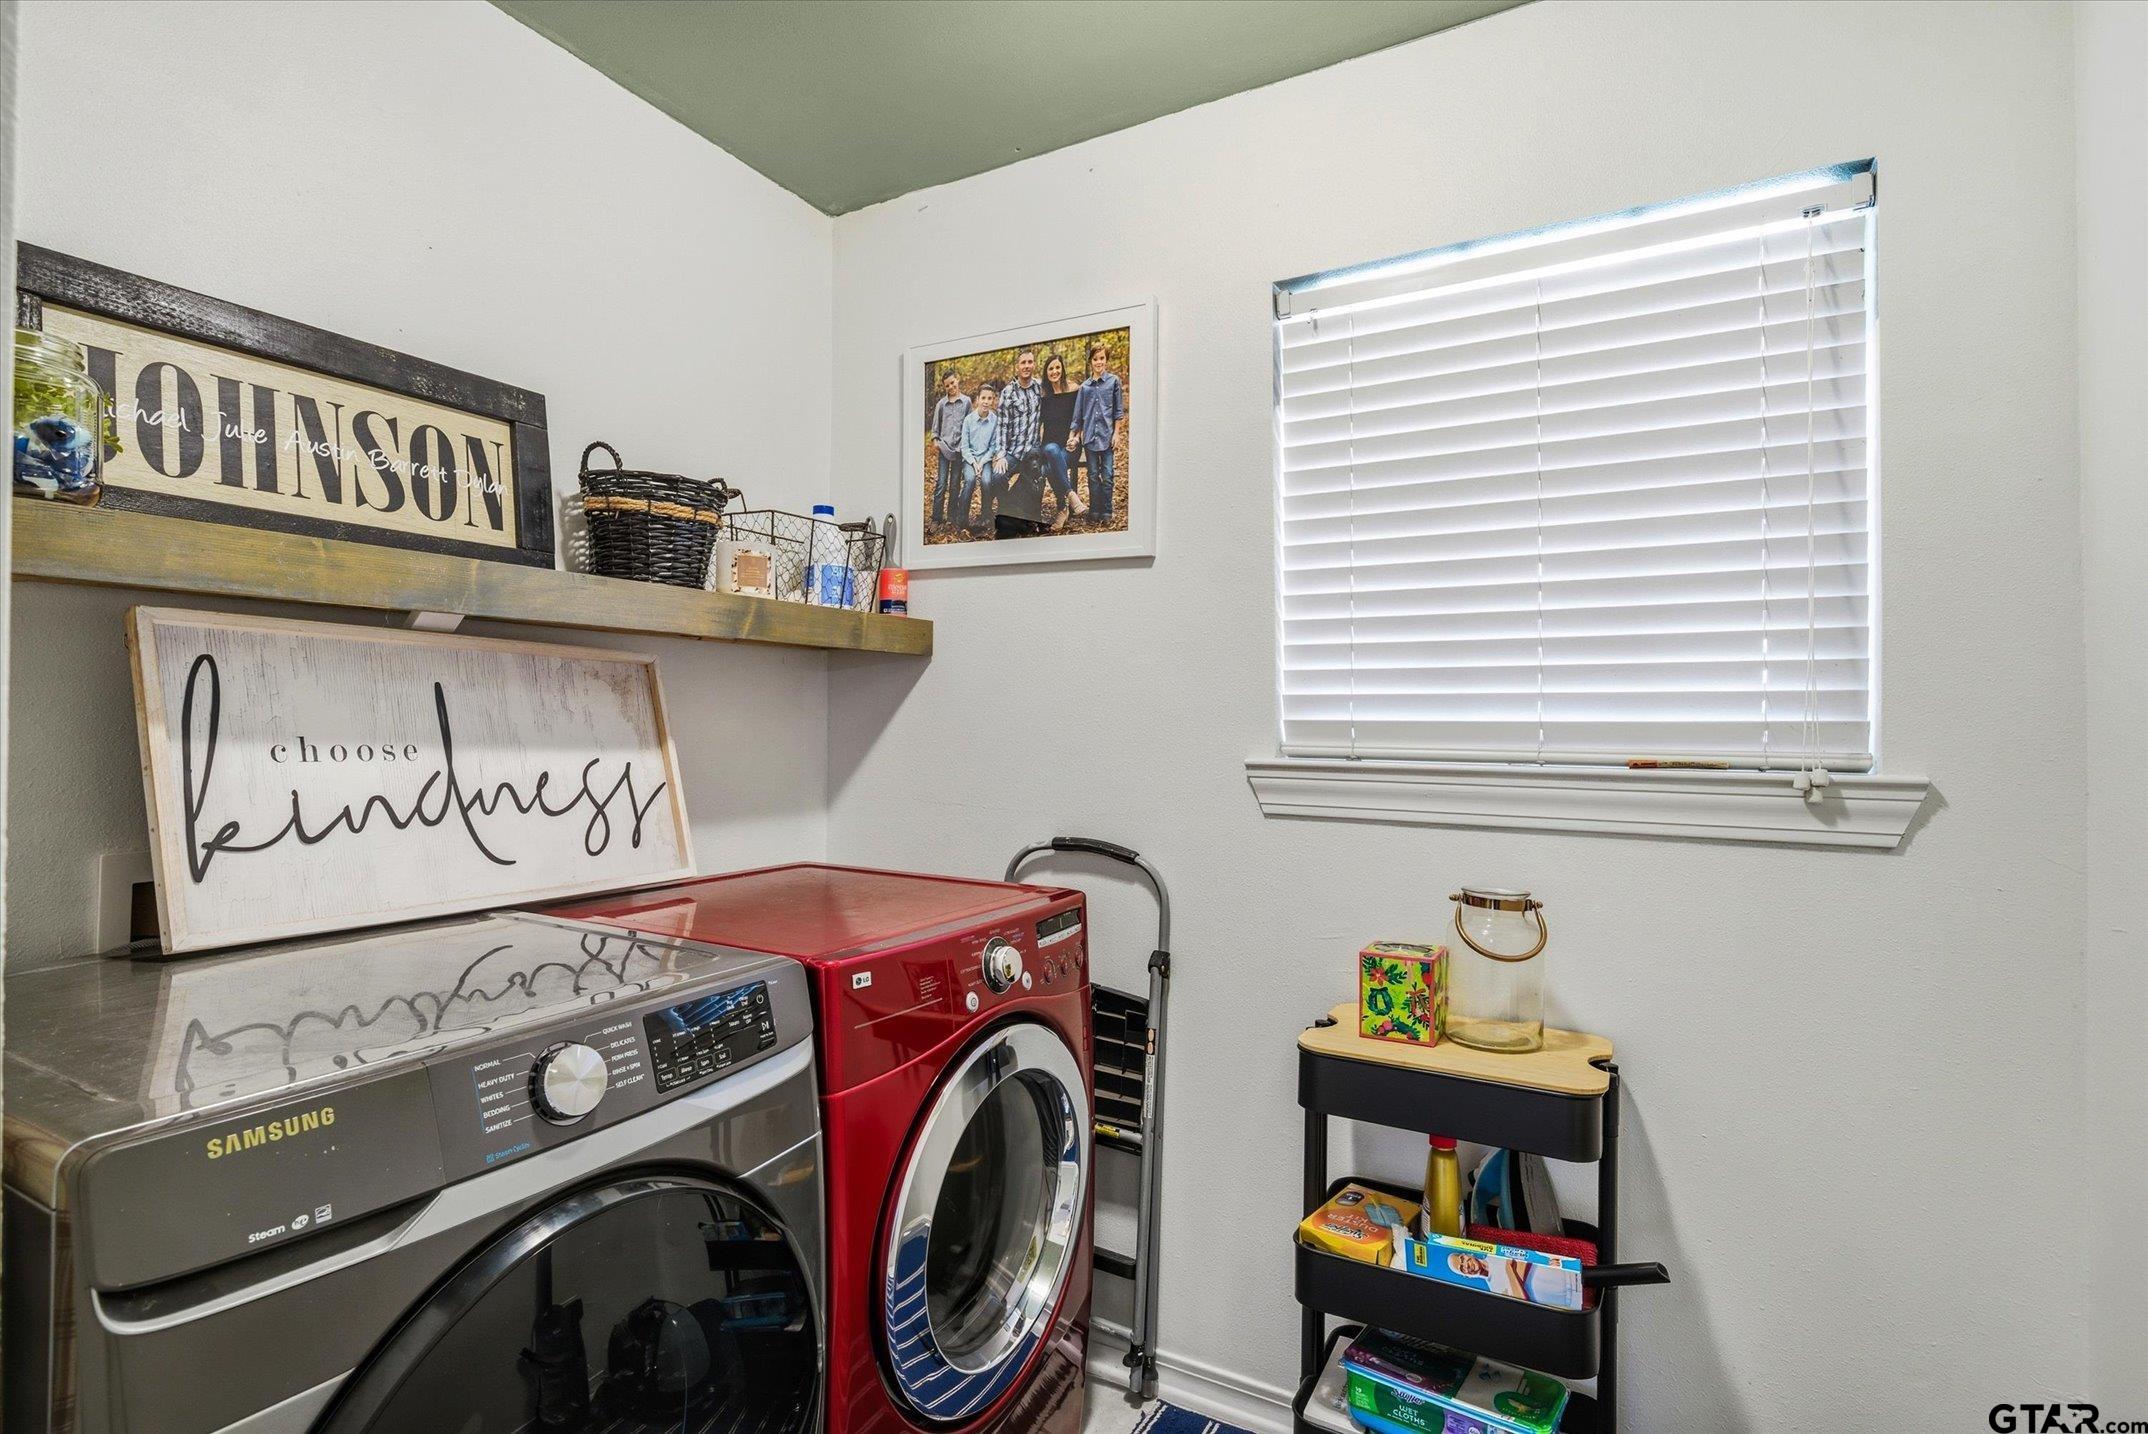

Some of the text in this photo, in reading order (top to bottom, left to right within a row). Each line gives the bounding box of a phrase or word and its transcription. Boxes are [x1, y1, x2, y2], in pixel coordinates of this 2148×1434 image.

[78, 342, 504, 532] JOHNSON
[103, 398, 508, 496] ichael Jue Austin Barrett Dylan
[269, 735, 419, 764] choose
[181, 653, 666, 884] kindness
[474, 1060, 501, 1072] NORMAL
[477, 1073, 515, 1089] HEAVY DUTY
[480, 1091, 504, 1104] WHITES
[482, 1104, 511, 1119] BEDDING
[206, 1106, 336, 1160] SAMSUNG
[485, 1119, 513, 1134] SANITIZE
[248, 1225, 286, 1244] Steam
